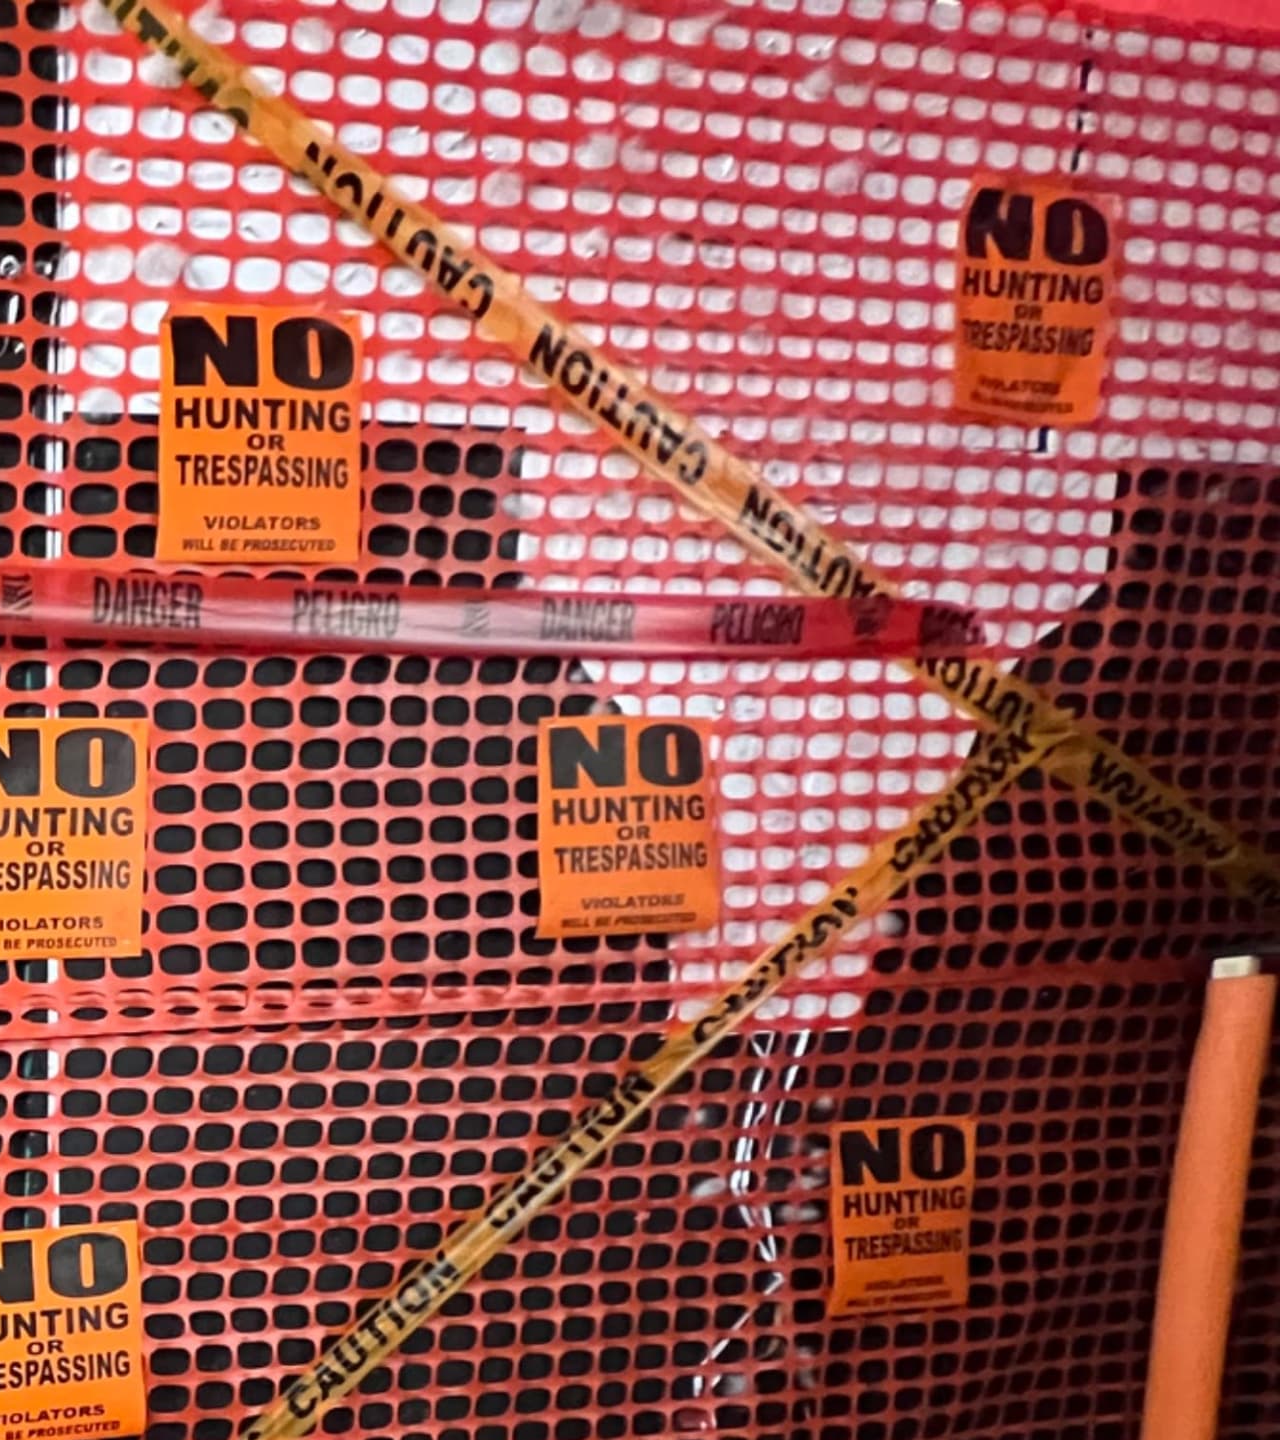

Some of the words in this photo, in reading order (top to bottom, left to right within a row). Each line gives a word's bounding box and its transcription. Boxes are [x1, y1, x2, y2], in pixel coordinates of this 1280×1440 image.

[965, 188, 1109, 266] NO
[962, 267, 1103, 304] HUNTING
[170, 315, 354, 391] NO
[175, 398, 350, 432] HUNTING
[529, 323, 708, 485] CAUTION
[247, 434, 285, 451] OR
[175, 455, 348, 489] TRESPASSING
[204, 516, 320, 530] VIOLATORS
[182, 539, 216, 551] WILL
[221, 539, 237, 551] BE
[243, 539, 335, 551] PROSECUTED
[93, 576, 204, 629] DANGER
[549, 724, 703, 790] NO
[553, 795, 705, 825] HUNTING
[26, 841, 64, 856] OR
[617, 825, 650, 841] OR
[554, 842, 707, 874] TRESPASSING
[4, 939, 21, 950] BE
[27, 936, 117, 949] PROSECUTED
[840, 1124, 966, 1185] NO
[844, 1186, 965, 1218] HUNTING
[27, 1340, 63, 1355] OR
[288, 1250, 461, 1419] CAUTION
[6, 1429, 22, 1440] BE
[28, 1420, 120, 1438] PROSECUTED
